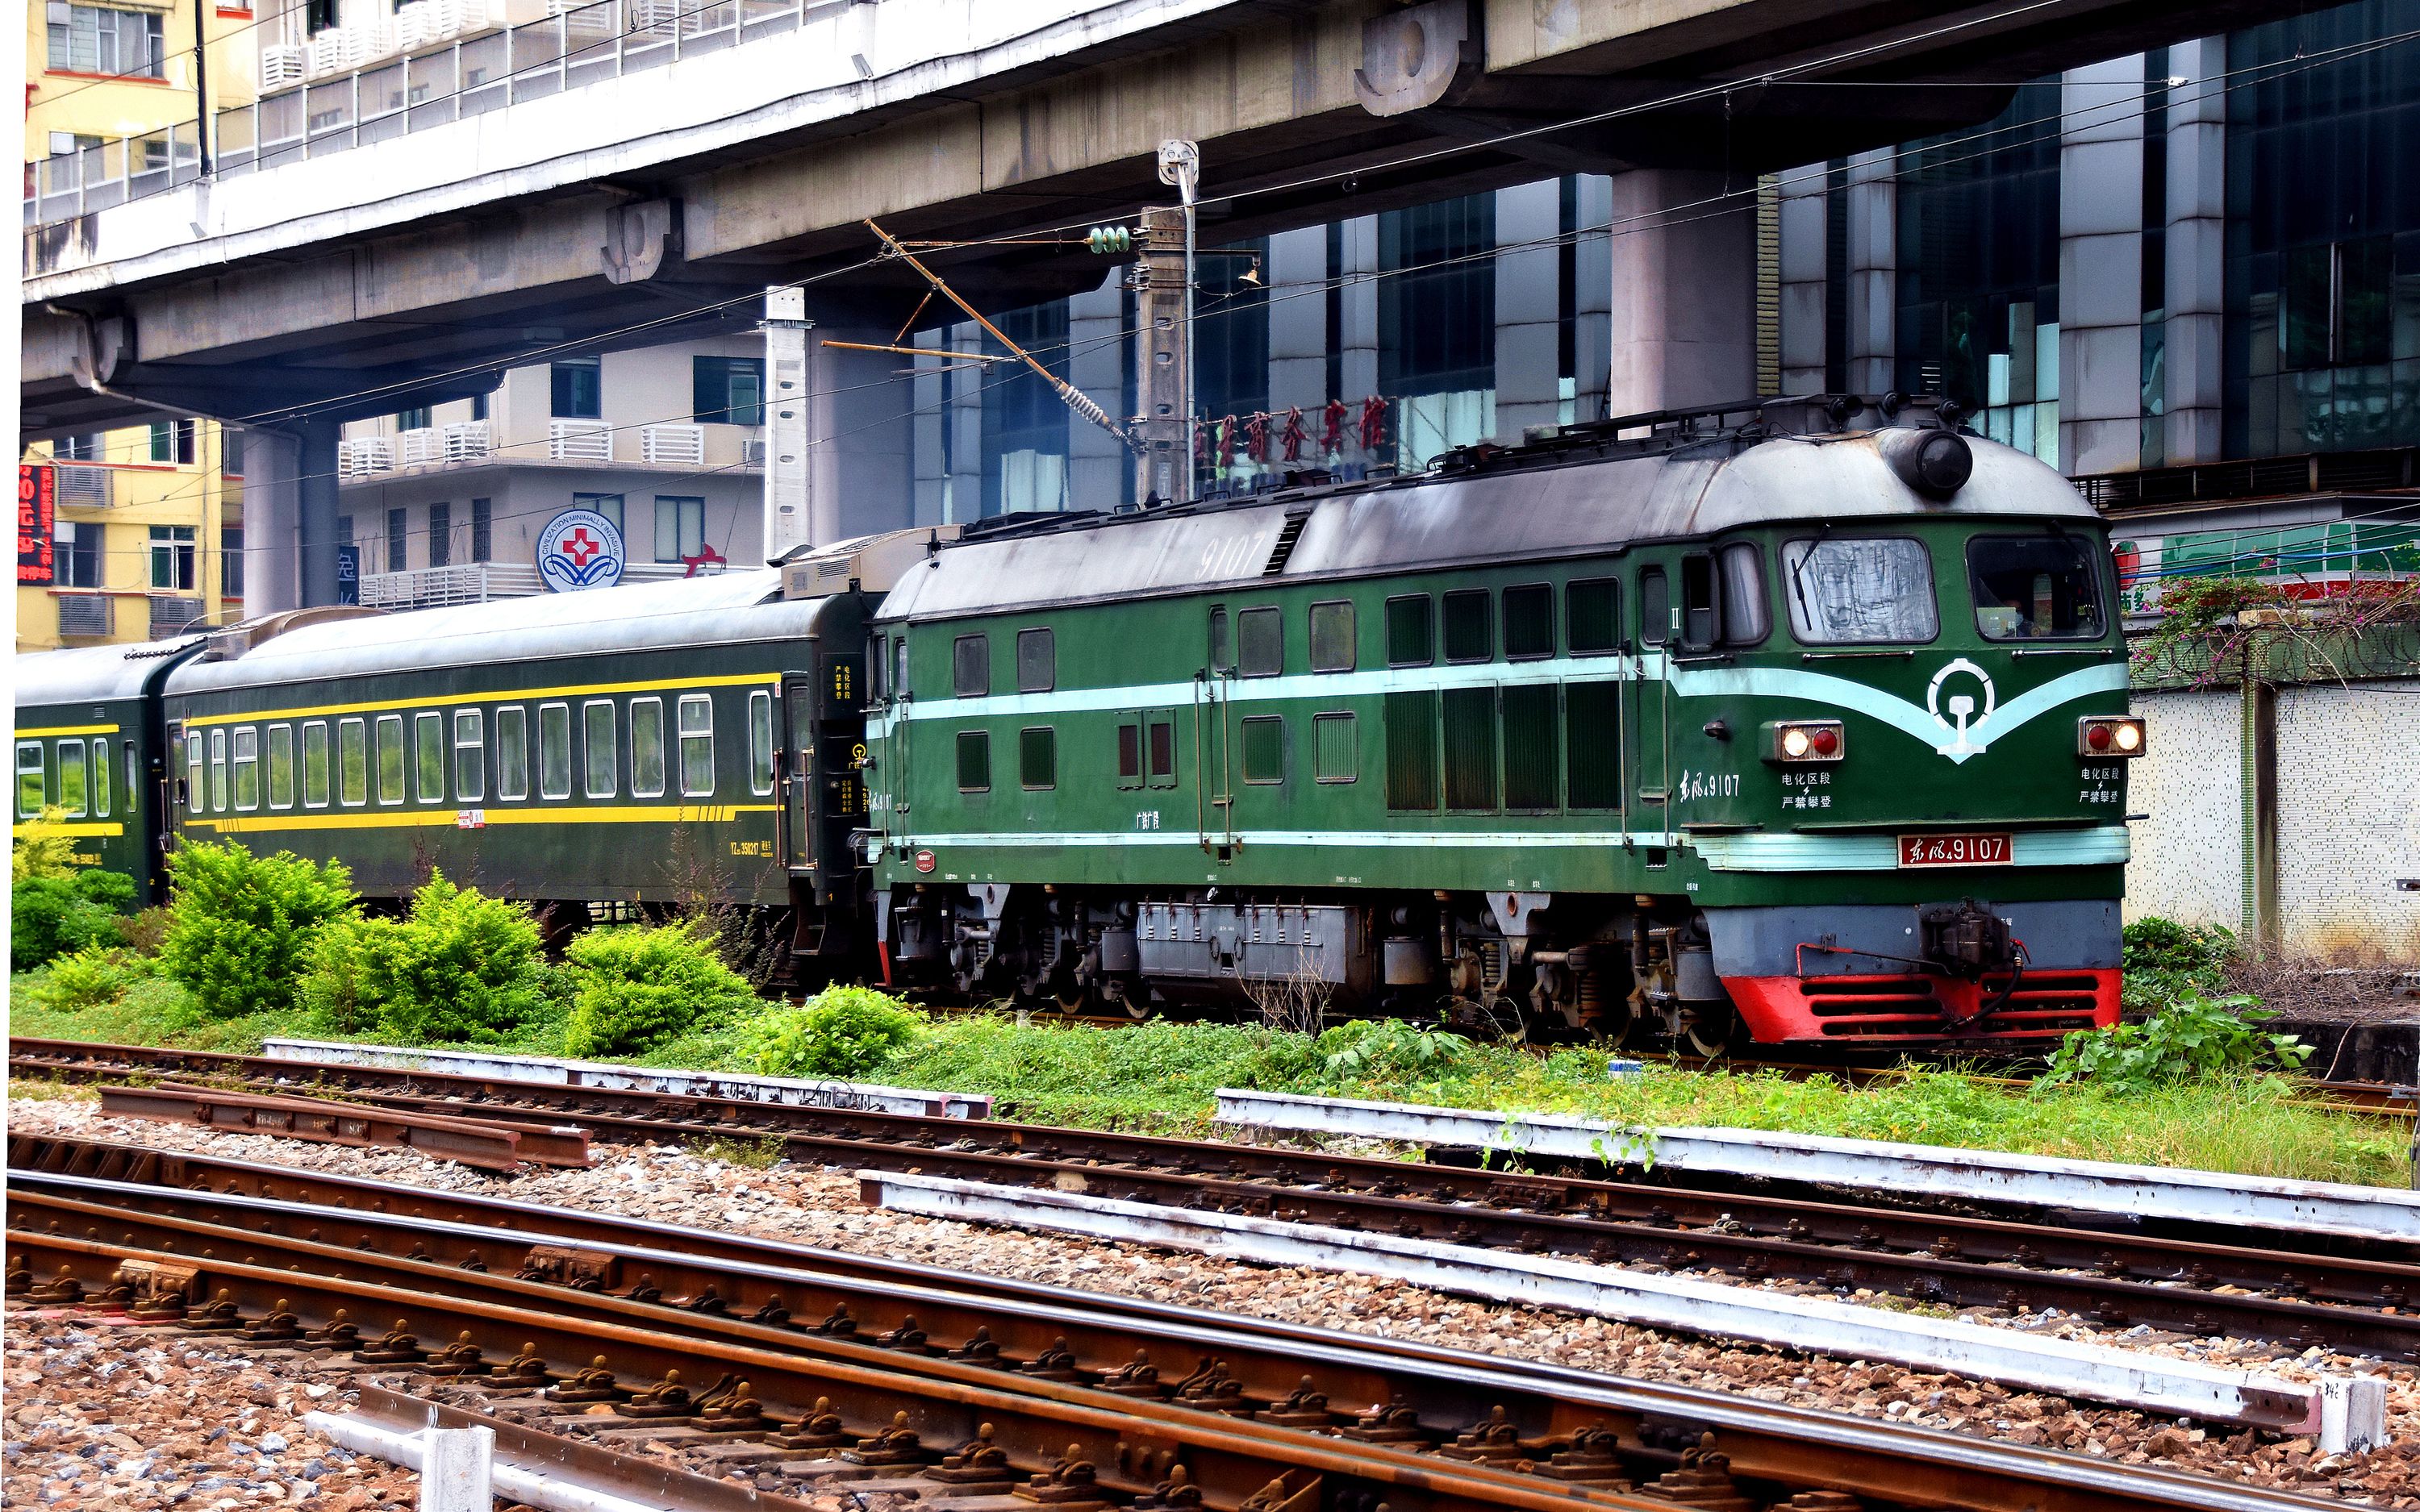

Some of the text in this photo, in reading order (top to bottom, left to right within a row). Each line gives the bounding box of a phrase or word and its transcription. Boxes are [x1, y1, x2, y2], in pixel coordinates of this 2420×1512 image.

[542, 514, 620, 557] CIVILIZATION MINIMALLY INVASIVE
[1194, 531, 1266, 581] 9107
[1781, 772, 1831, 785] 电化区段
[2081, 767, 2119, 780] 电化区段
[1781, 795, 1832, 809] 严禁攀登
[2079, 790, 2118, 803] 严禁攀登
[1136, 810, 1160, 831] 广铁广段
